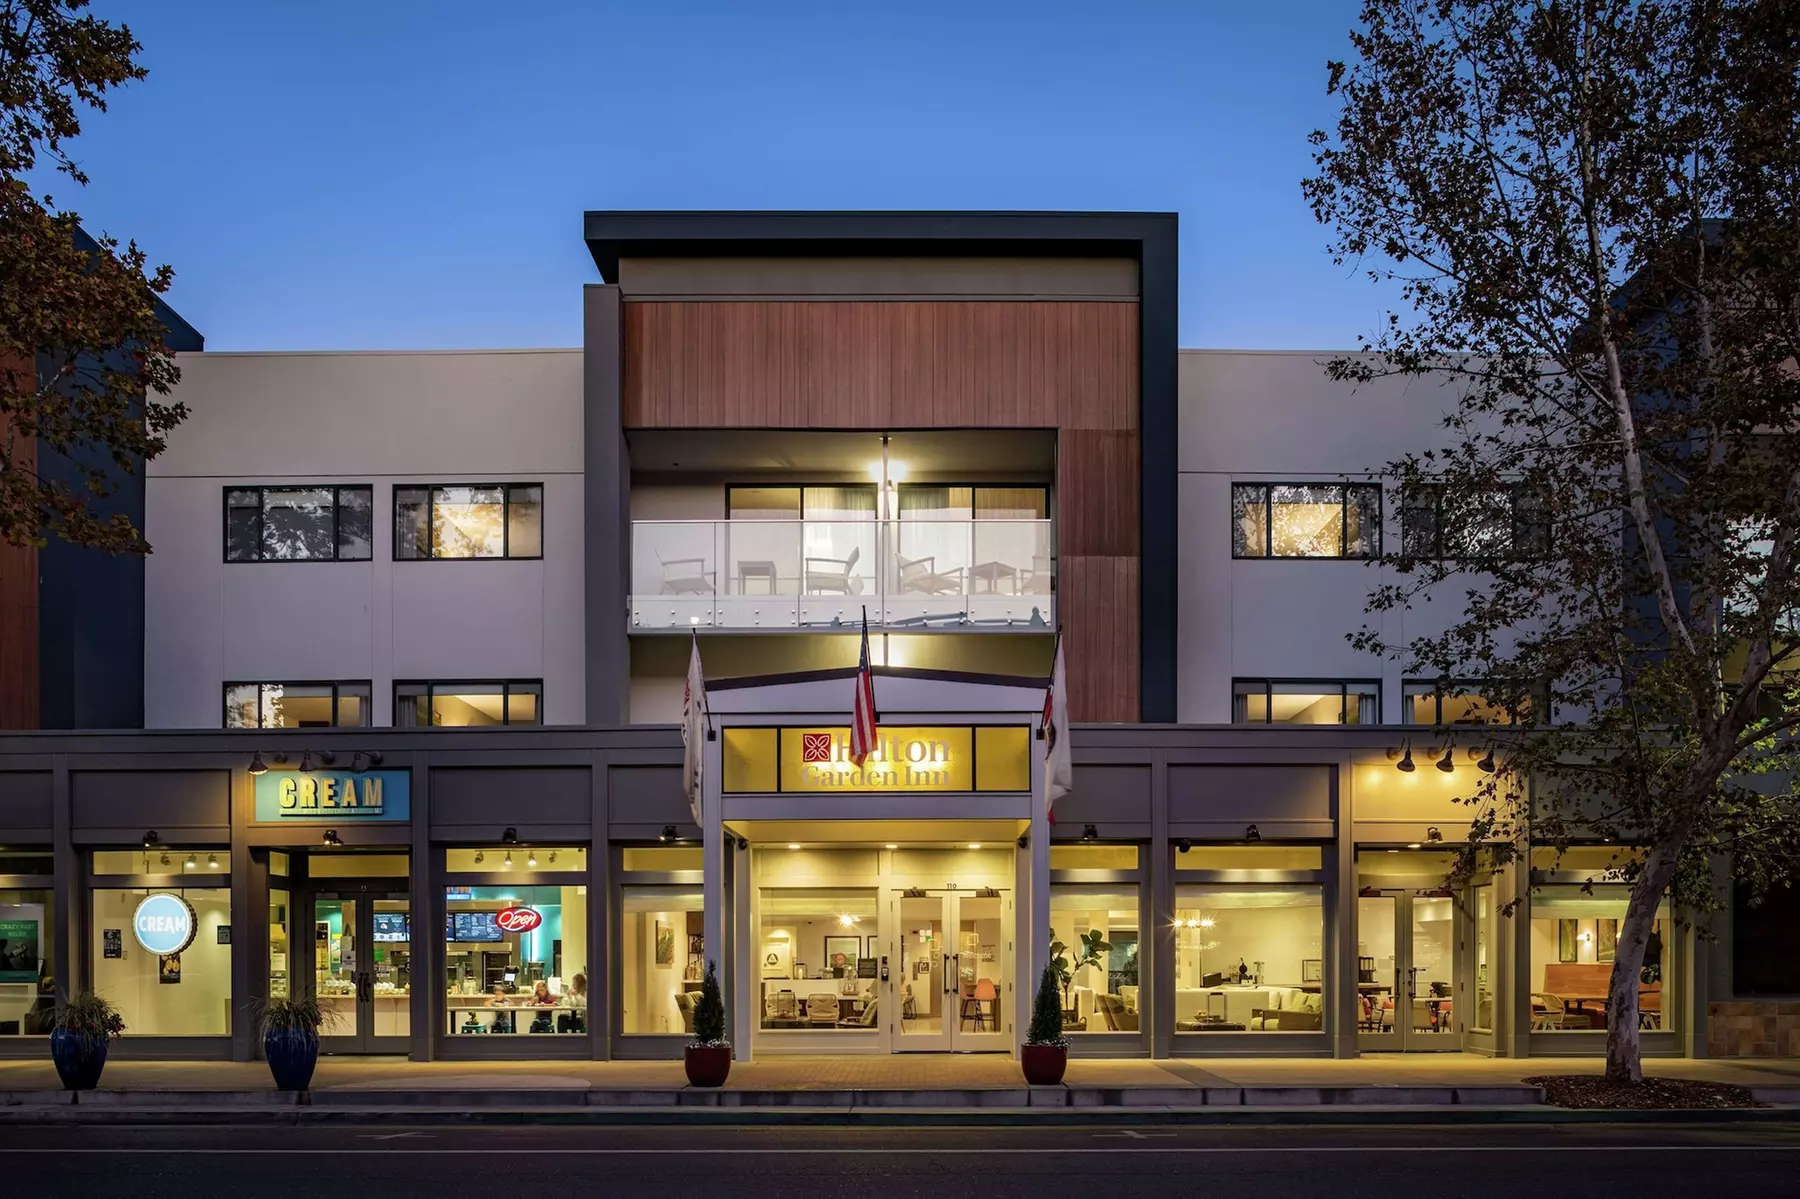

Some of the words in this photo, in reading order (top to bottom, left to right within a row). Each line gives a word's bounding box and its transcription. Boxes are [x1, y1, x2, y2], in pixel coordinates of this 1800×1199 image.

[803, 766, 898, 786] Garden
[904, 766, 950, 786] Inn
[279, 777, 384, 808] CREAM
[138, 916, 186, 933] CREAM
[498, 911, 537, 929] Open
